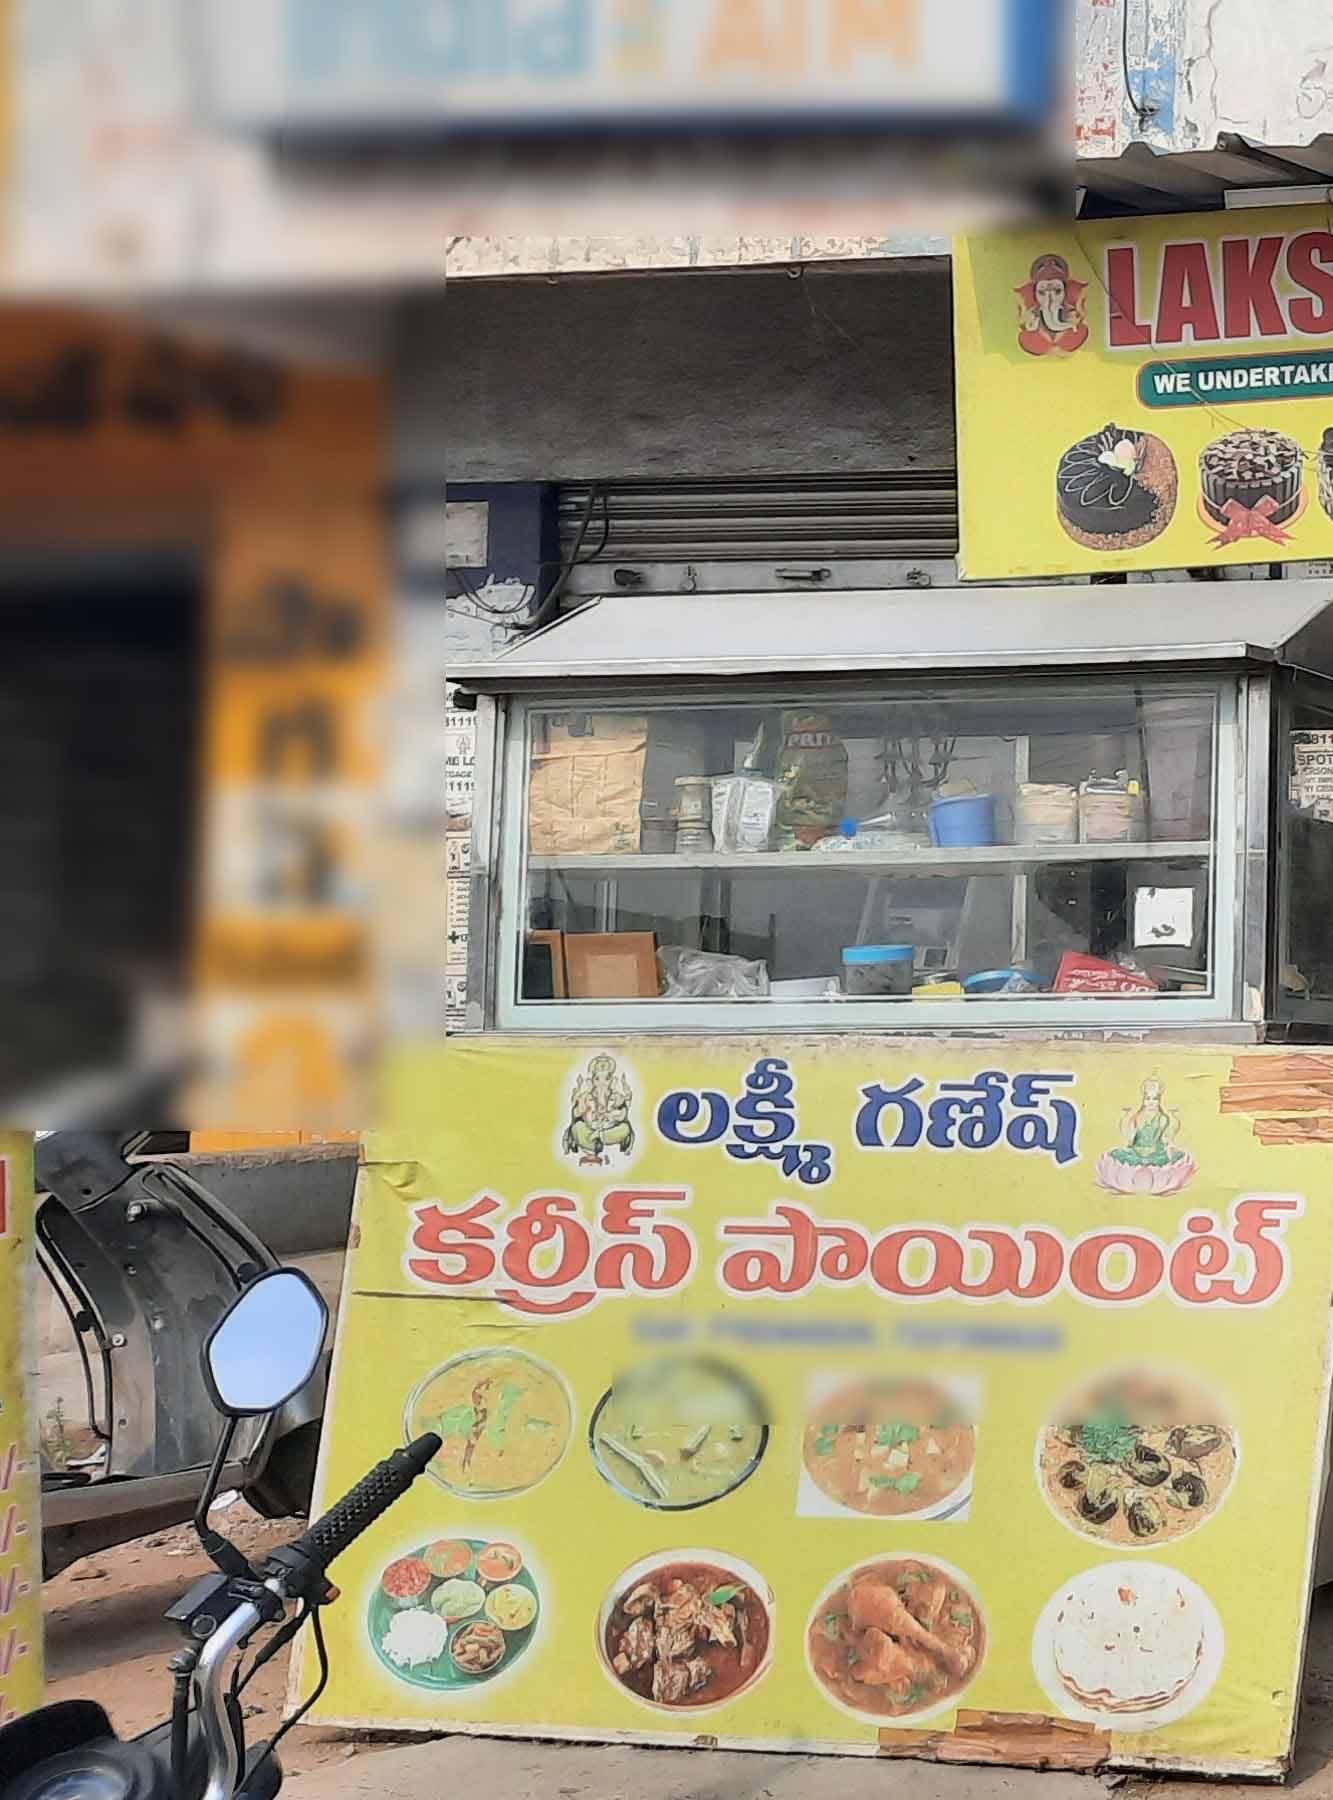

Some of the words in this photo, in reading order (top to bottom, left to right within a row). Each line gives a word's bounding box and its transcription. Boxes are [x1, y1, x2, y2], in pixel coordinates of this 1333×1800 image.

[1154, 371, 1190, 393] WE
[657, 1058, 832, 1184] లక్ష్మీ
[855, 1070, 1079, 1165] గణేష్
[408, 1190, 693, 1315] కర్రీస్
[722, 1200, 1298, 1304] పాయింట్
